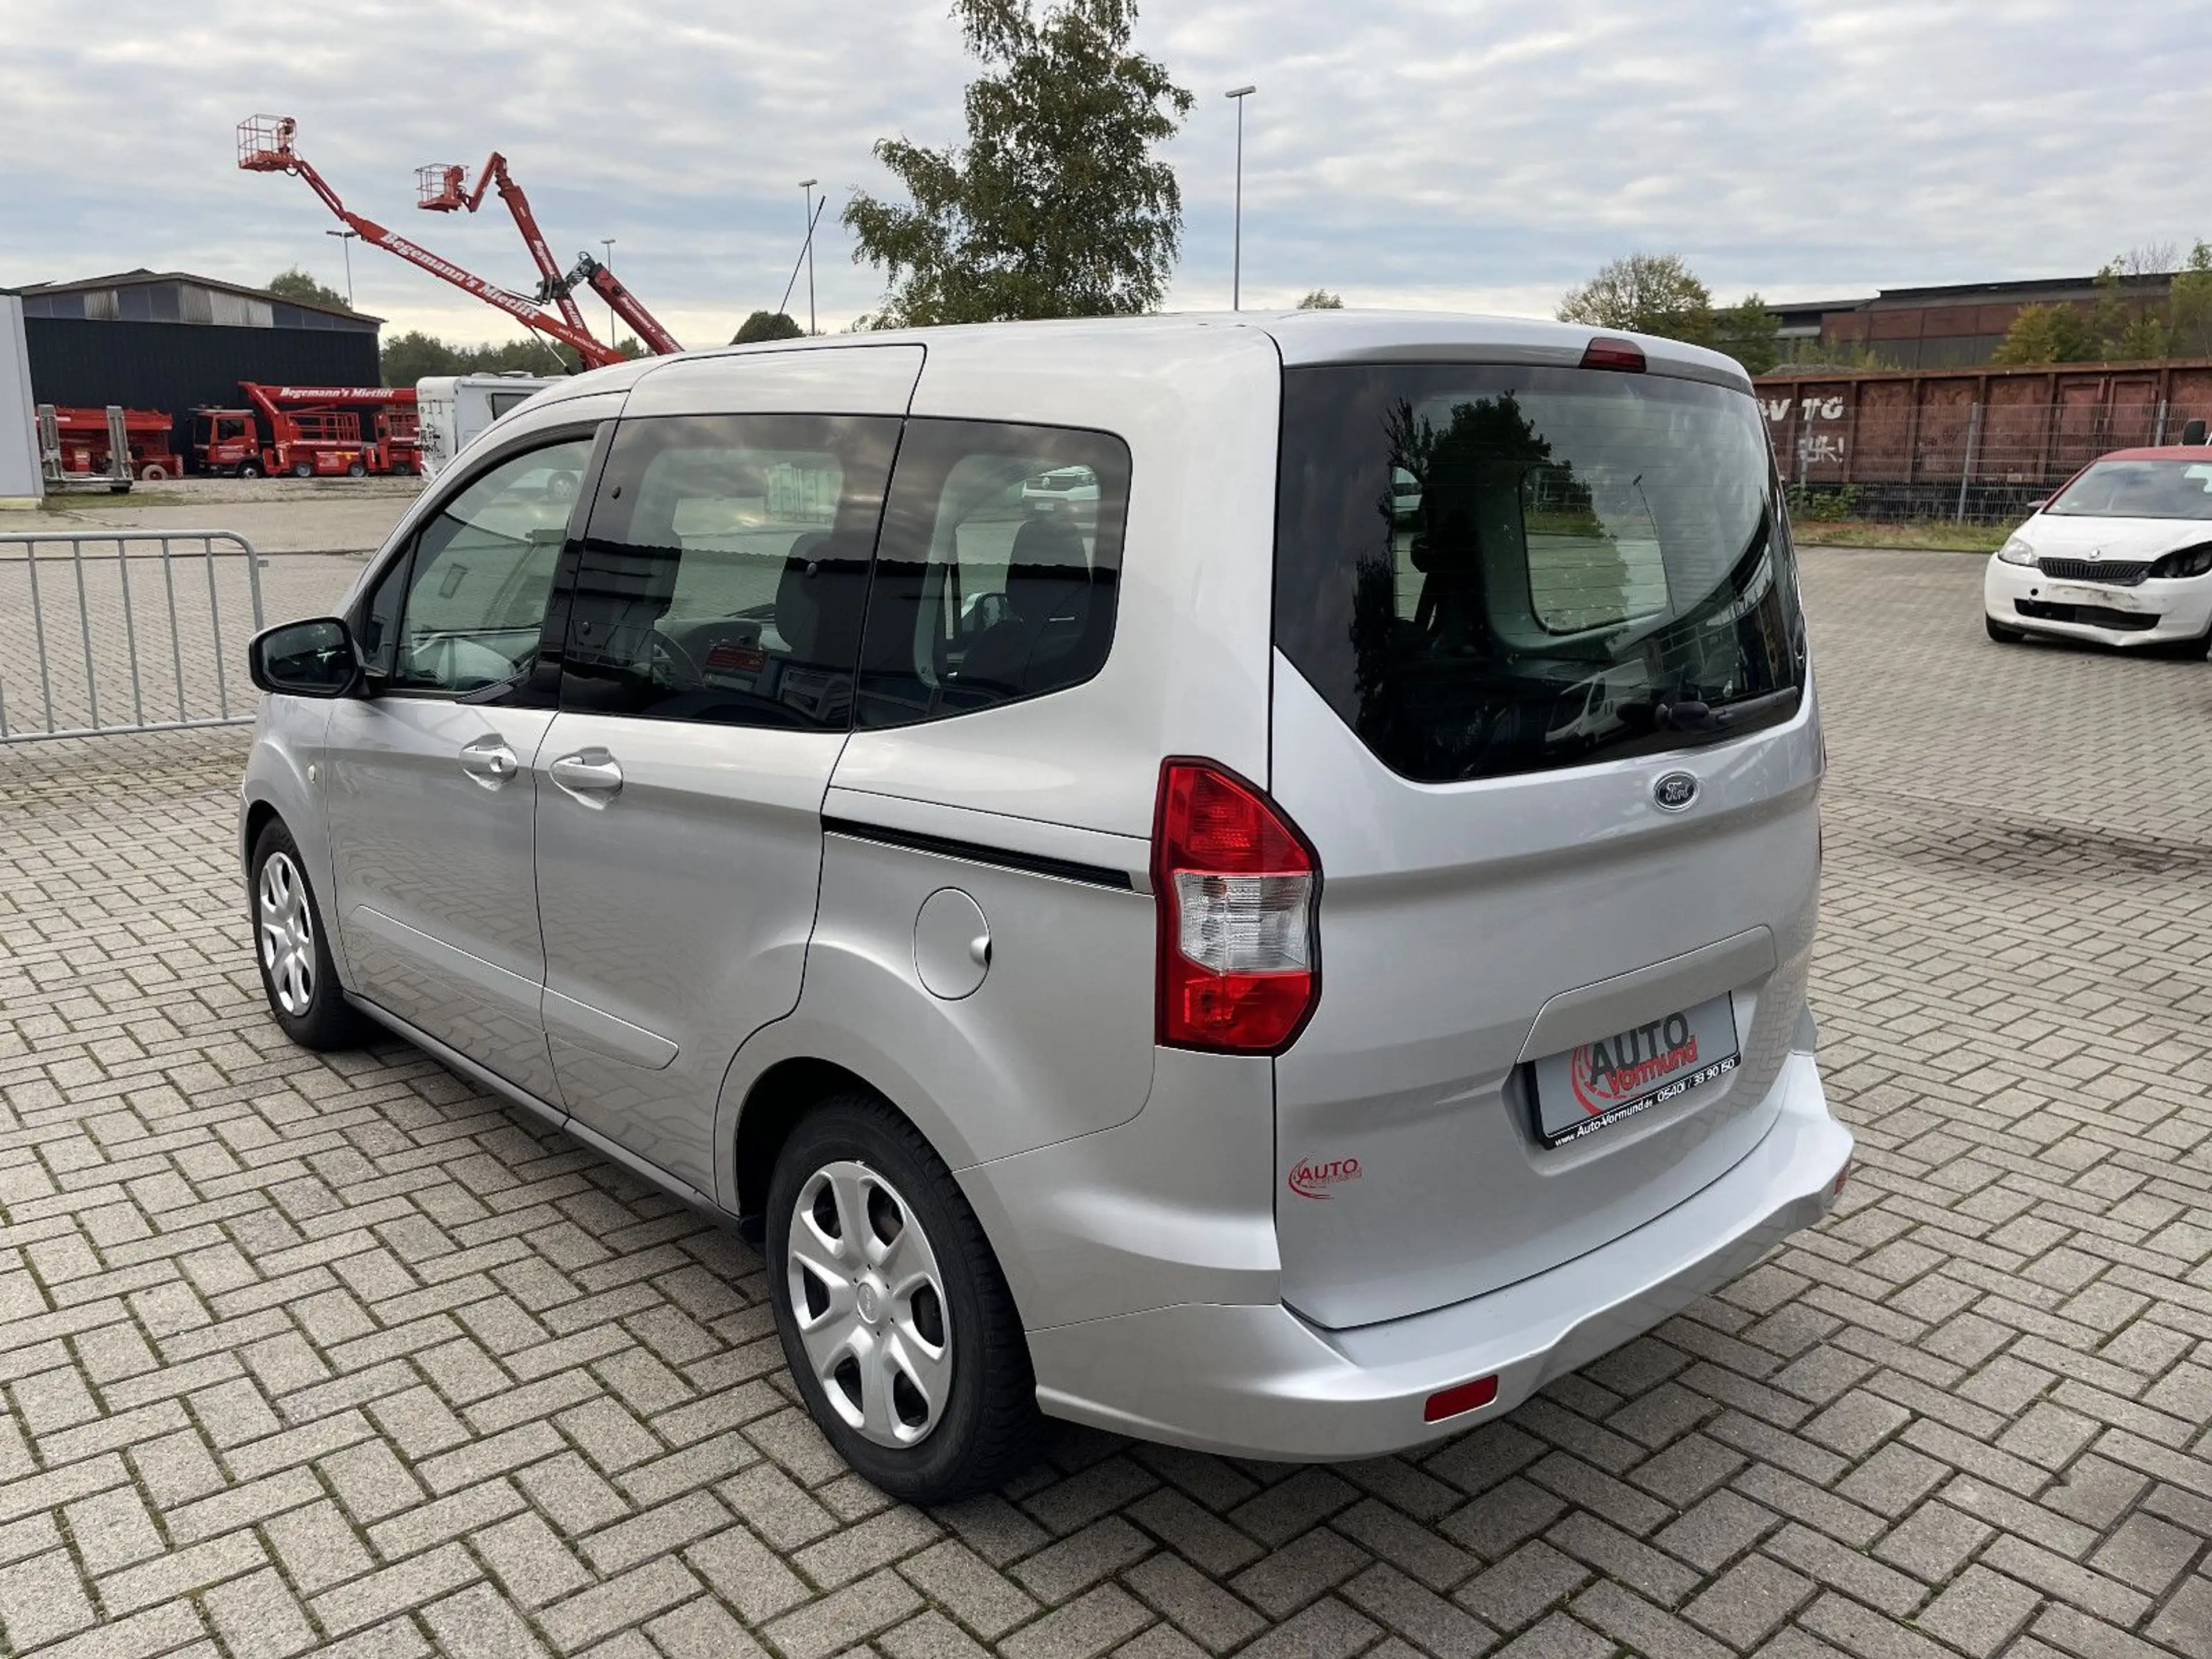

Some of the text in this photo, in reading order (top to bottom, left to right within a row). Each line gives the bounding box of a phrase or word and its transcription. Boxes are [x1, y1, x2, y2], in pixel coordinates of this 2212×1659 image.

[380, 232, 479, 288] Begemann's
[279, 387, 349, 399] Begemann's
[1590, 1012, 1689, 1086] AUTO
[1605, 1033, 1699, 1095] Vormund
[1296, 1158, 1359, 1185] AUTO
